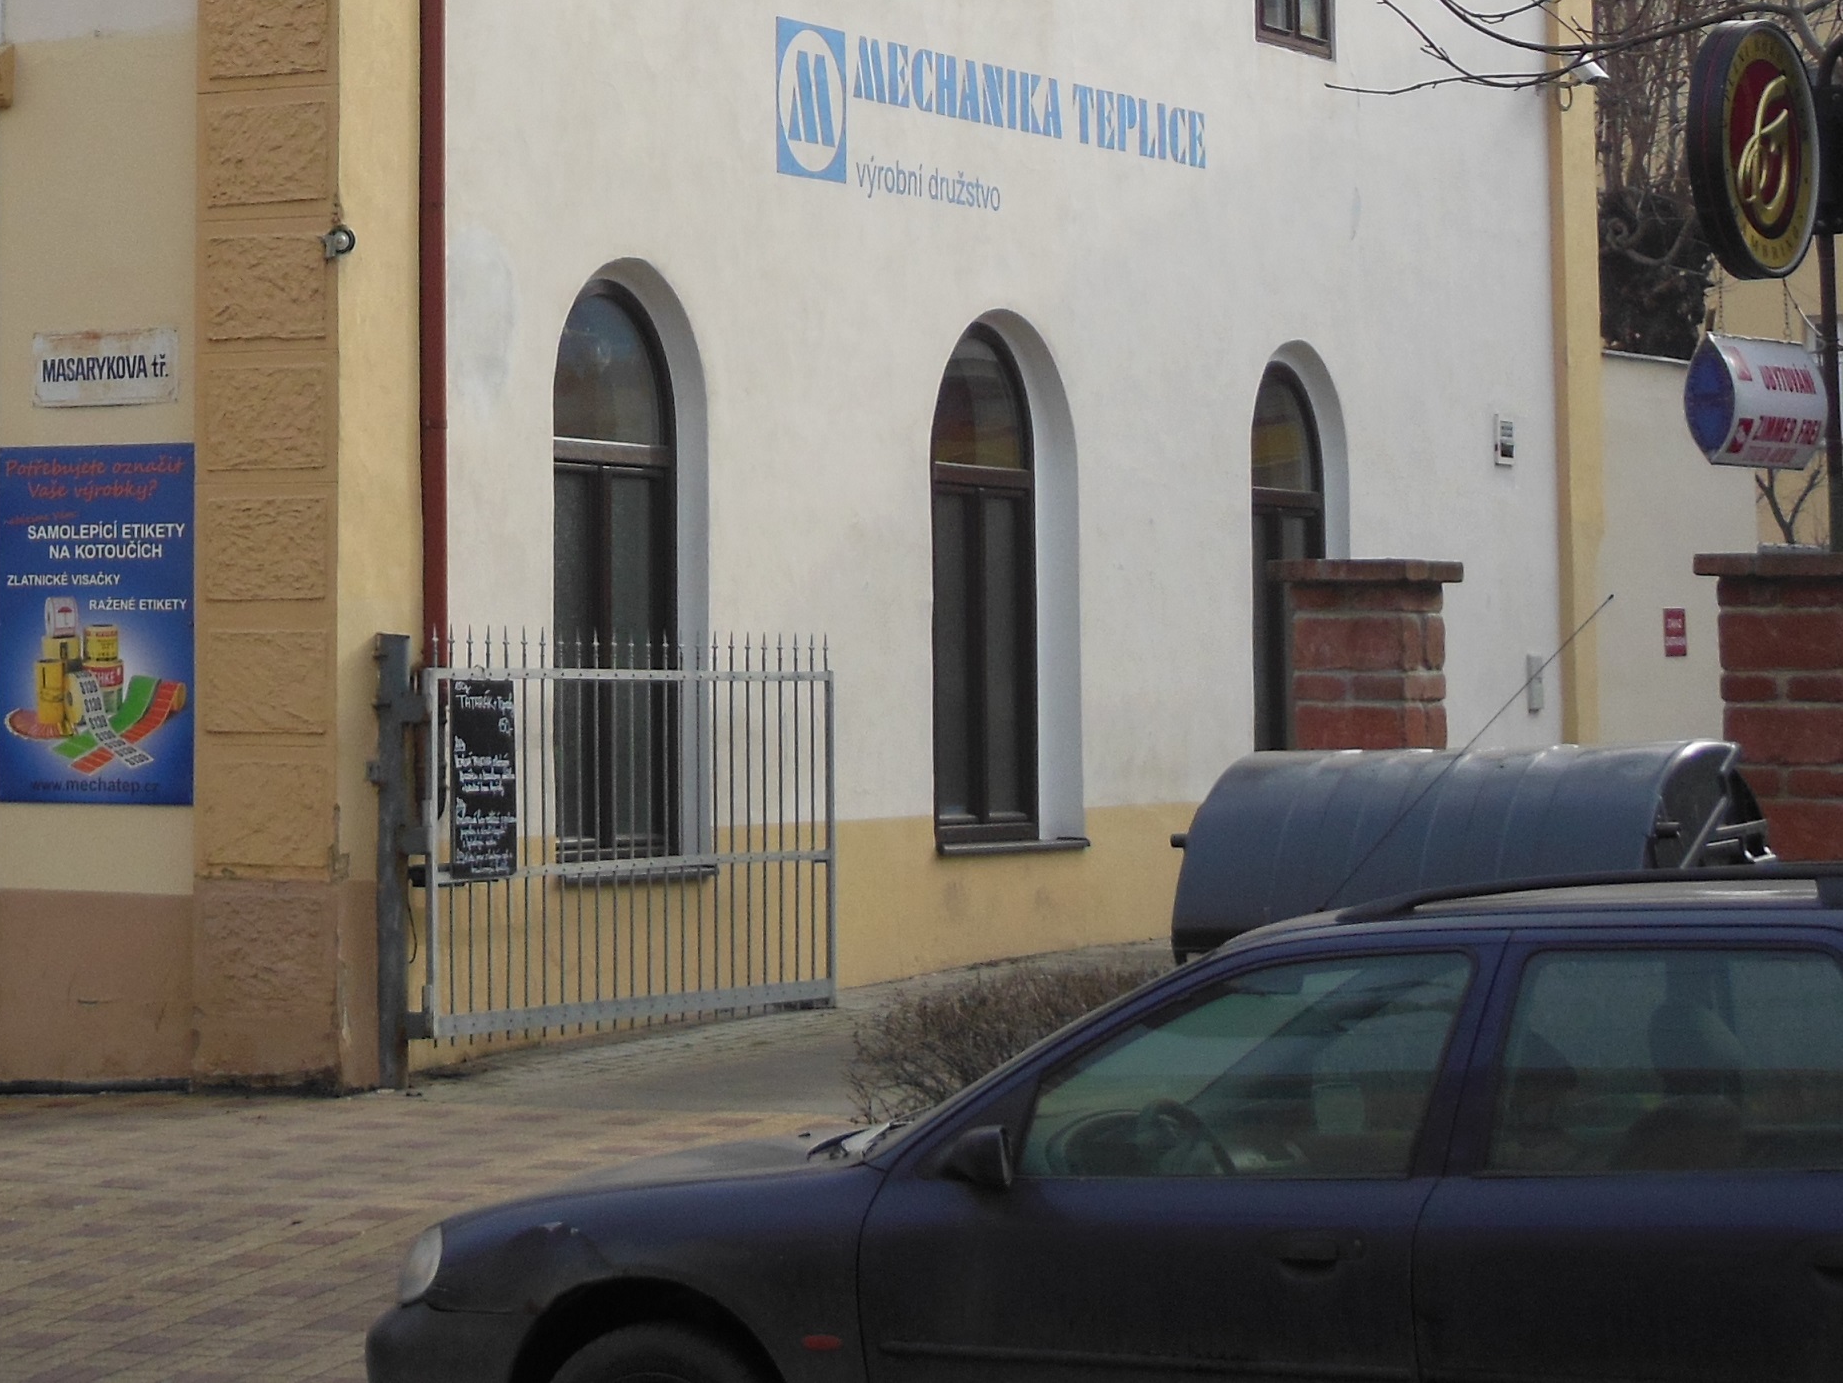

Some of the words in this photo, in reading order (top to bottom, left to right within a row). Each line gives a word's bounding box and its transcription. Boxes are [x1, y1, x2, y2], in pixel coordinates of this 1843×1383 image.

[853, 35, 1062, 139] MECHANIKA
[1072, 83, 1206, 169] TEPLICE
[855, 155, 923, 198] výrobní
[928, 168, 1001, 212] družstvo
[42, 354, 148, 383] MASARYKOVA
[151, 353, 169, 378] tř.
[6, 458, 105, 478] Potřebujete
[112, 454, 185, 474] označit
[27, 479, 69, 500] Vaše
[74, 478, 158, 503] výrobky?
[27, 520, 118, 540] SAMOLEPÍCÍ
[121, 523, 186, 539] ETIKETY
[49, 544, 70, 560] NA
[74, 540, 163, 559] KOTOUČÍCH
[6, 571, 69, 586] ZLATNICKÉ
[71, 570, 121, 586] VISAČKY
[89, 596, 136, 611] RAŽENÉ
[139, 599, 188, 611] ETIKETY
[30, 777, 161, 796] www.mechatep.cz
